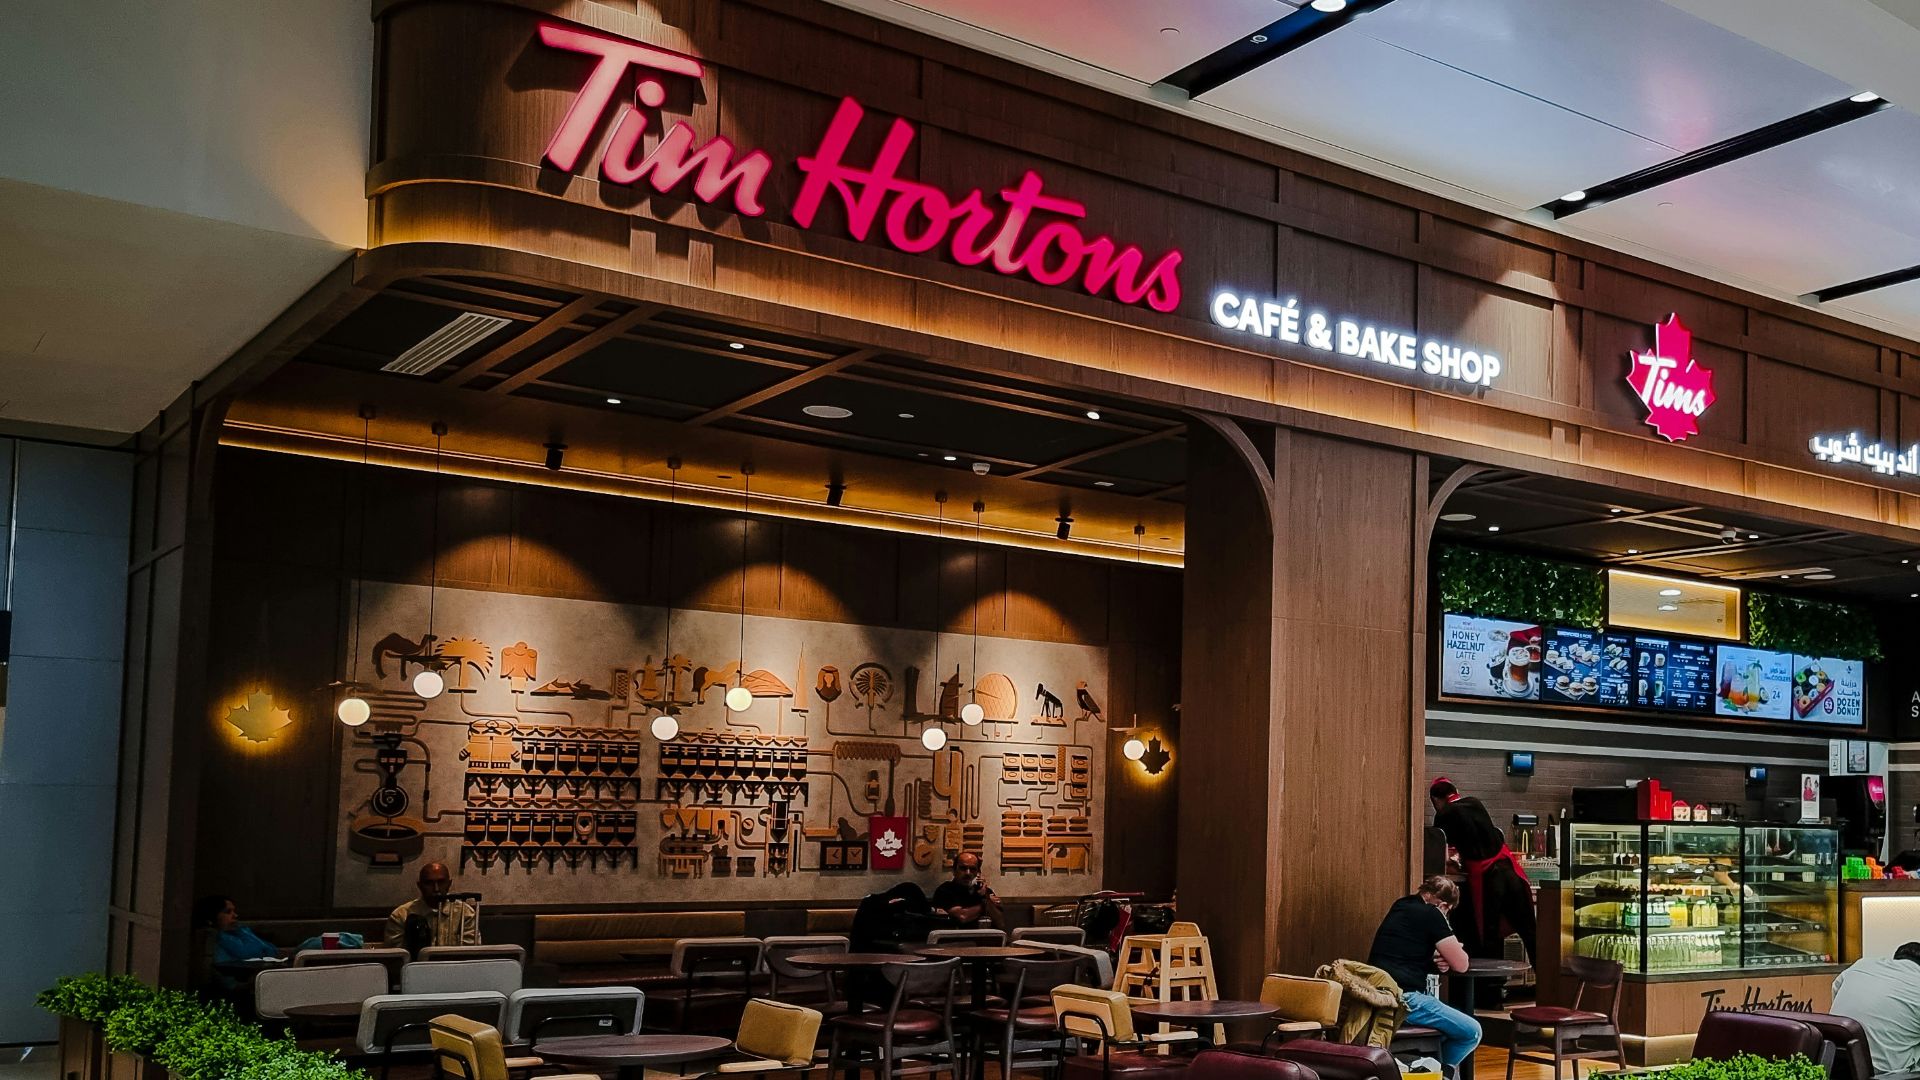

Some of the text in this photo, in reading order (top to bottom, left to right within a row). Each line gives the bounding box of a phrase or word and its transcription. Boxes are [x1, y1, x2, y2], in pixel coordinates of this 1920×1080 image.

[537, 22, 1183, 313] Tim Hortons
[1210, 292, 1500, 386] CAFÉ & BAKE SHOP
[1638, 355, 1705, 417] Tims
[1809, 432, 1862, 463] شوب
[1452, 630, 1480, 641] HONEY
[1446, 640, 1485, 652] HAZELNUT
[1456, 651, 1476, 660] LATTE
[1461, 667, 1470, 675] 23
[1836, 698, 1860, 708] DOZEN
[1836, 706, 1860, 717] DONUT
